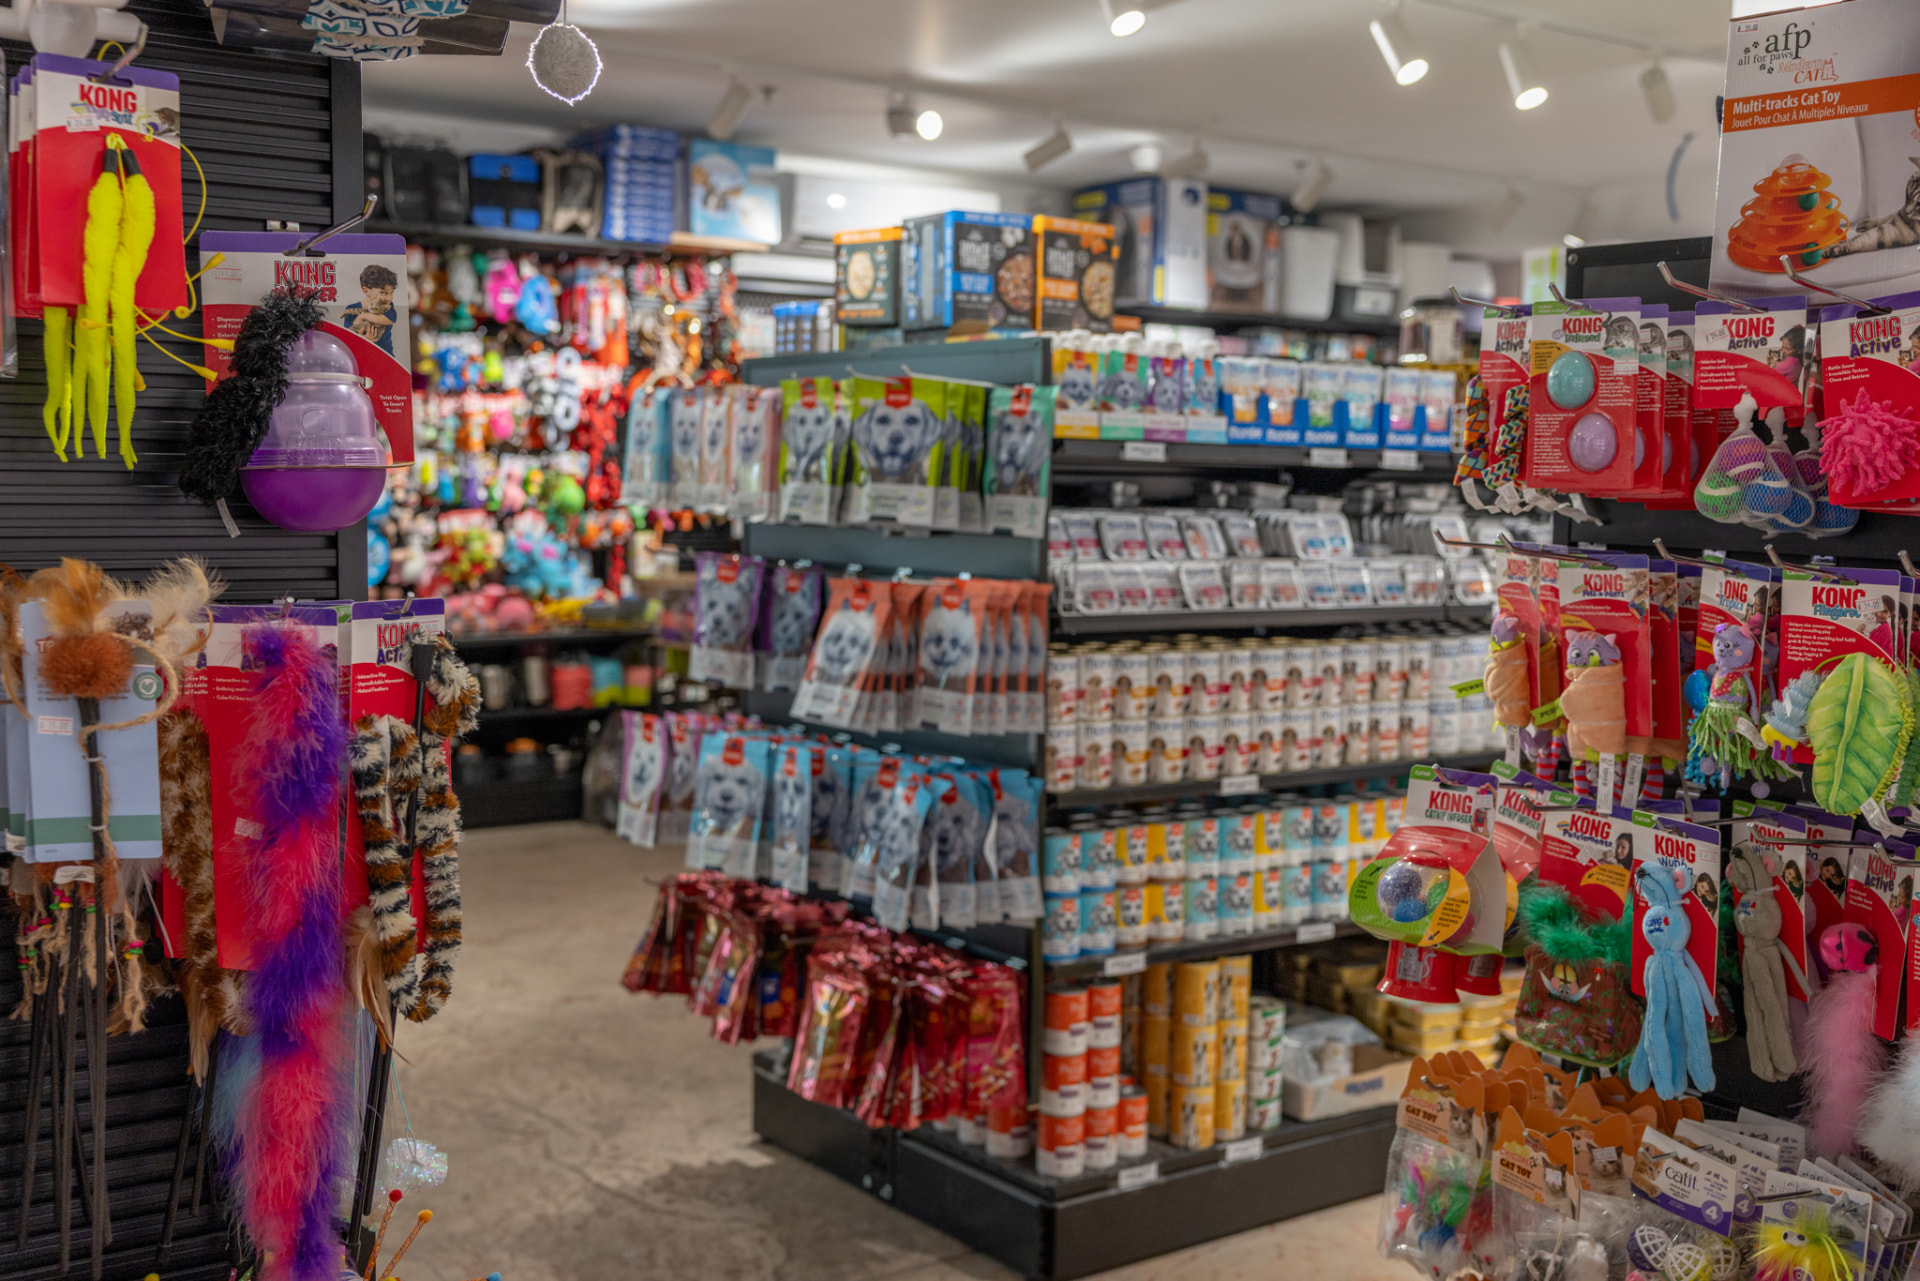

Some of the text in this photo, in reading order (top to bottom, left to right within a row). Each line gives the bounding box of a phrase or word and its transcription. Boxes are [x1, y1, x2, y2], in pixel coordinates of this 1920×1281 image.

[1765, 22, 1811, 60] afp
[1738, 50, 1794, 66] all for paws
[80, 84, 137, 114] KONG
[1732, 90, 1841, 114] Multi-tracks Cat Toy
[1732, 116, 1752, 128] Jouet
[1754, 114, 1772, 126] Pour
[1772, 111, 1790, 124] Chat
[1799, 106, 1836, 120] Multiples
[1837, 103, 1869, 114] Niveaux
[274, 260, 336, 287] KONG
[1497, 321, 1527, 340] KONG
[1562, 317, 1603, 334] KONG
[1722, 316, 1775, 338] KONG
[1849, 316, 1902, 344] KONG
[1495, 339, 1524, 352] Active
[1728, 336, 1768, 350] Active
[1850, 336, 1902, 358] Active
[1584, 574, 1624, 592] KONG
[1718, 580, 1748, 604] ONG
[1428, 790, 1473, 814] KONG
[1569, 814, 1612, 840] KONG
[1654, 834, 1696, 864] KONG
[1868, 853, 1898, 880] KONG
[1864, 874, 1894, 892] Active
[1406, 1104, 1420, 1116] CAT
[1500, 1158, 1532, 1179] CAT TOY
[1705, 1206, 1718, 1220] 4
[1736, 1199, 1750, 1214] 4
